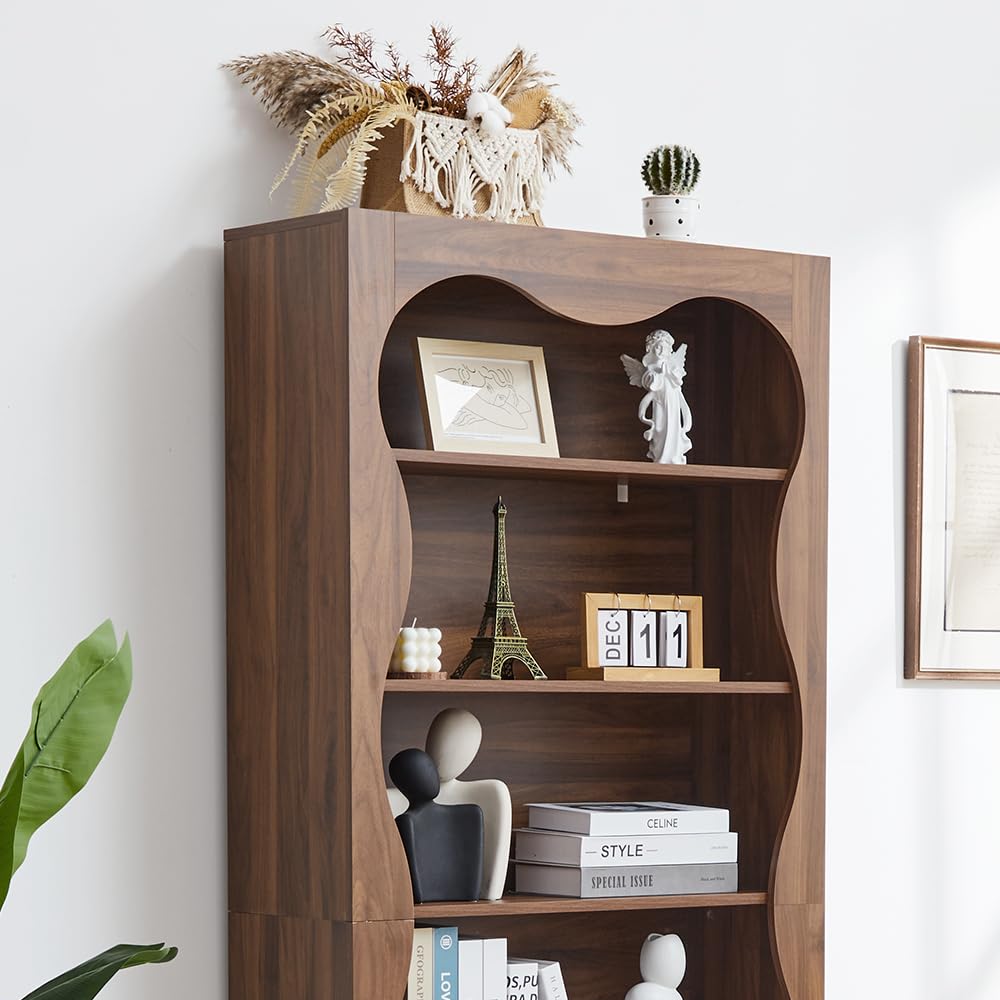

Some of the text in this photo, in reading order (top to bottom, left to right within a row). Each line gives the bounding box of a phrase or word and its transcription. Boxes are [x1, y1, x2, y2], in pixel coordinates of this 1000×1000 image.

[605, 620, 621, 660] DEC
[640, 623, 682, 659] 1 1
[647, 818, 678, 829] CELINE
[601, 844, 643, 858] STYLE
[591, 874, 654, 889] SPECIAL ISSUE
